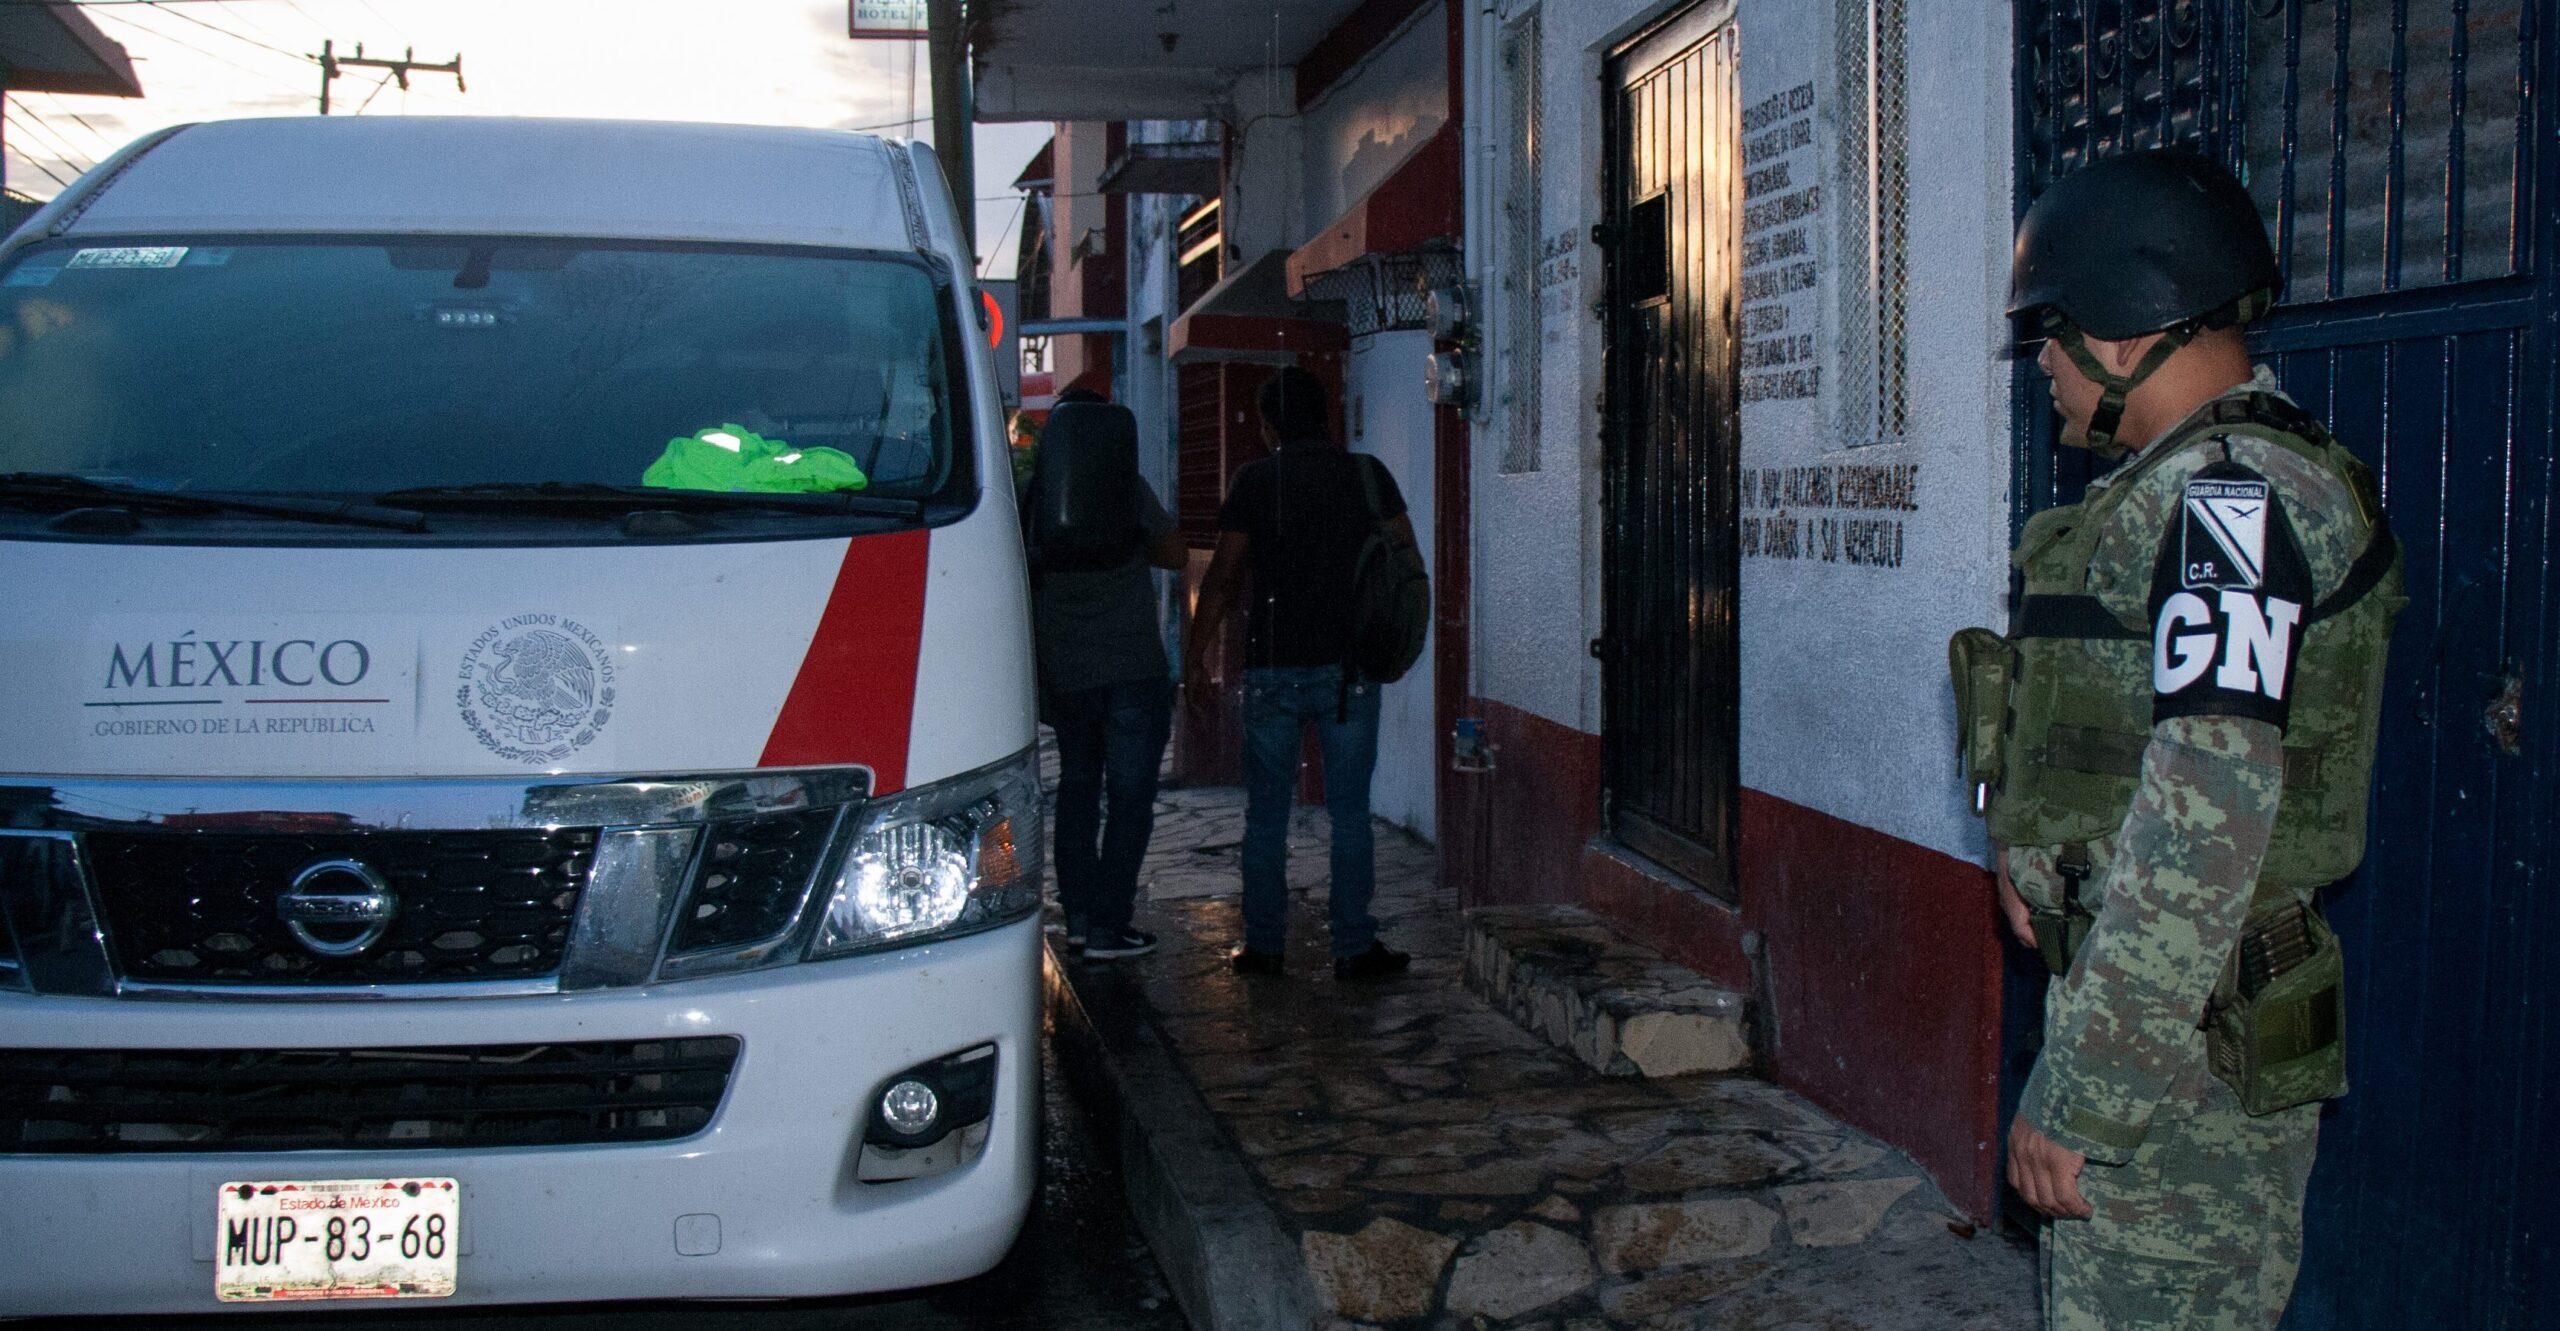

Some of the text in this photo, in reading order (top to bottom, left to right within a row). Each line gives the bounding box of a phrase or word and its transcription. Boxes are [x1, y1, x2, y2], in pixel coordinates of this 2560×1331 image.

[857, 8, 908, 20] HOTEL
[2188, 484, 2264, 498] GUARDIA NACIONAL
[1763, 509, 1800, 560] DAÑOS
[1805, 517, 1814, 560] A
[1820, 517, 1838, 563] SU
[1844, 518, 1904, 568] VEHICULO
[2188, 561, 2219, 581] C.R.
[104, 629, 371, 689] MÉXICO
[458, 612, 616, 685] ESTADOS UNIDOS MEXICANOS
[2153, 590, 2302, 701] GN
[94, 717, 198, 737] GOBIERNO
[201, 717, 229, 735] DE
[234, 717, 261, 735] LA
[279, 1197, 326, 1211] Estado
[329, 1195, 347, 1209] de
[226, 1213, 447, 1267] MUP-83-68
